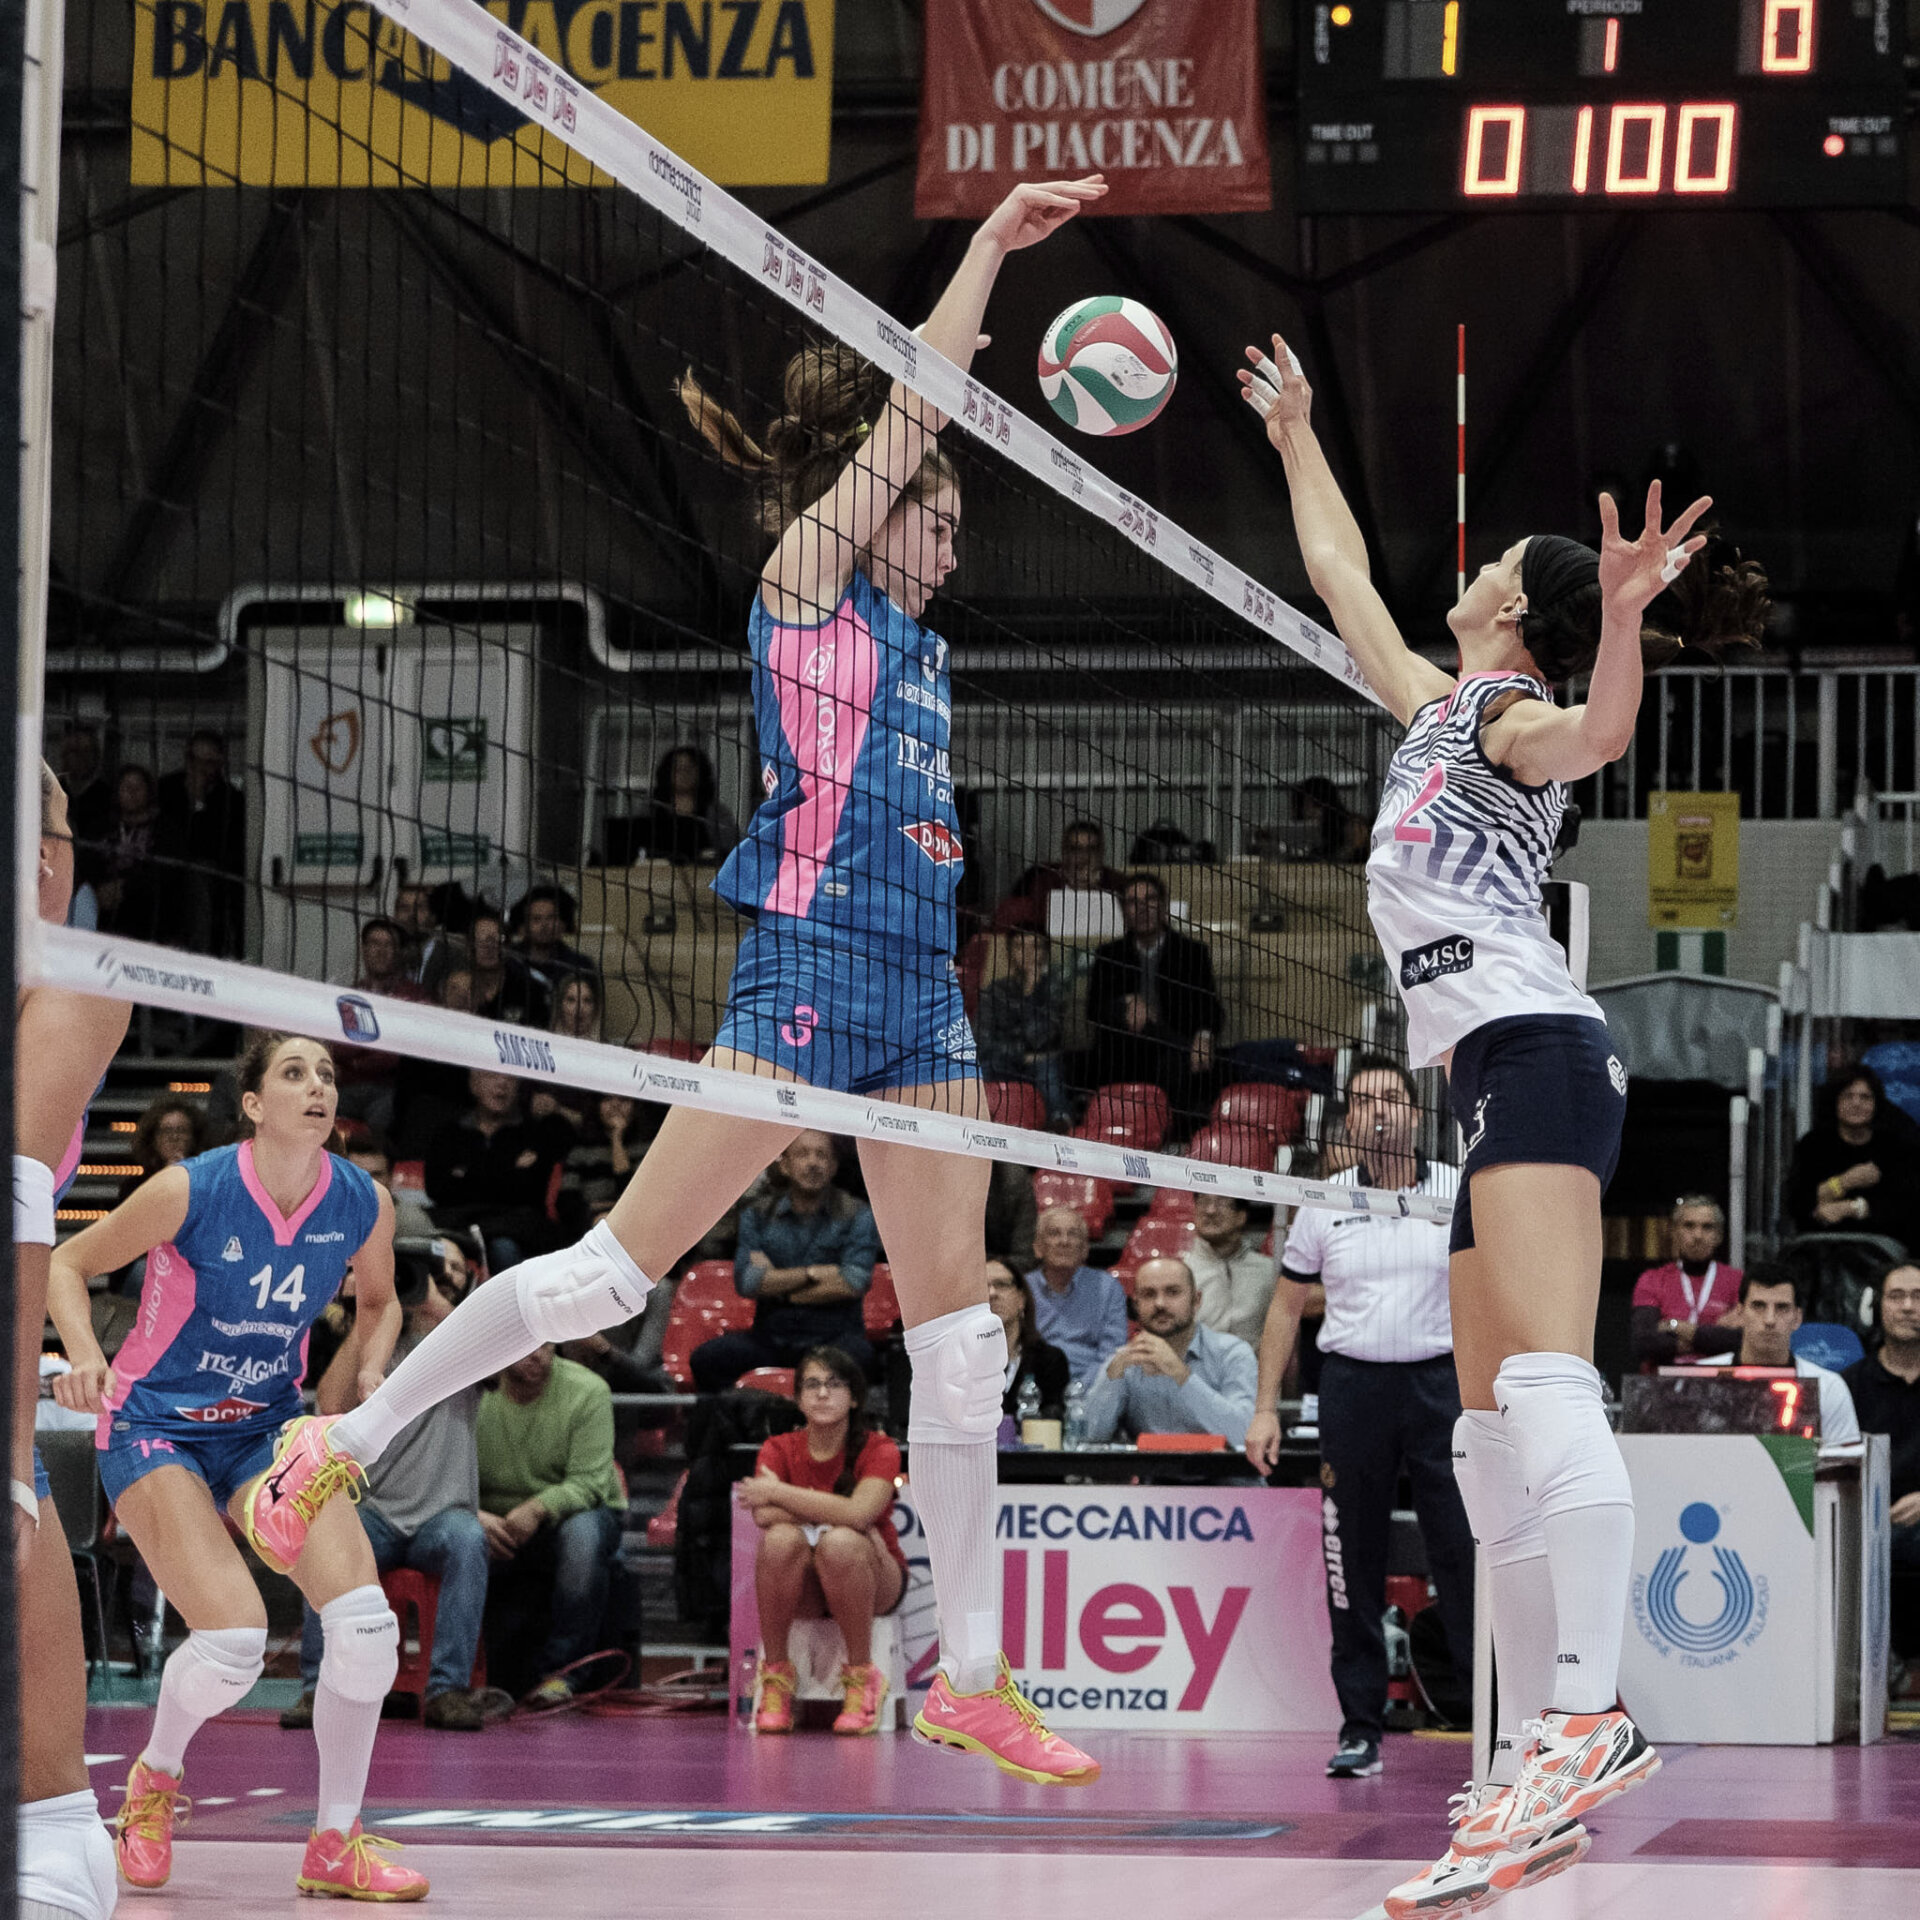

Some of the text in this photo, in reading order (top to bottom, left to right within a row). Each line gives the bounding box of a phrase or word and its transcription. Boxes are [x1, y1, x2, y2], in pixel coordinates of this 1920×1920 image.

[993, 59, 1196, 112] COMUNE
[946, 119, 1245, 172] DI PIACENZA
[1393, 761, 1446, 844] 2
[1418, 939, 1472, 972] MSC
[782, 1004, 819, 1048] 3
[494, 1030, 556, 1074] SAMSUNG
[304, 1229, 345, 1244] macron
[250, 1263, 307, 1312] 14
[1771, 1380, 1799, 1428] 7
